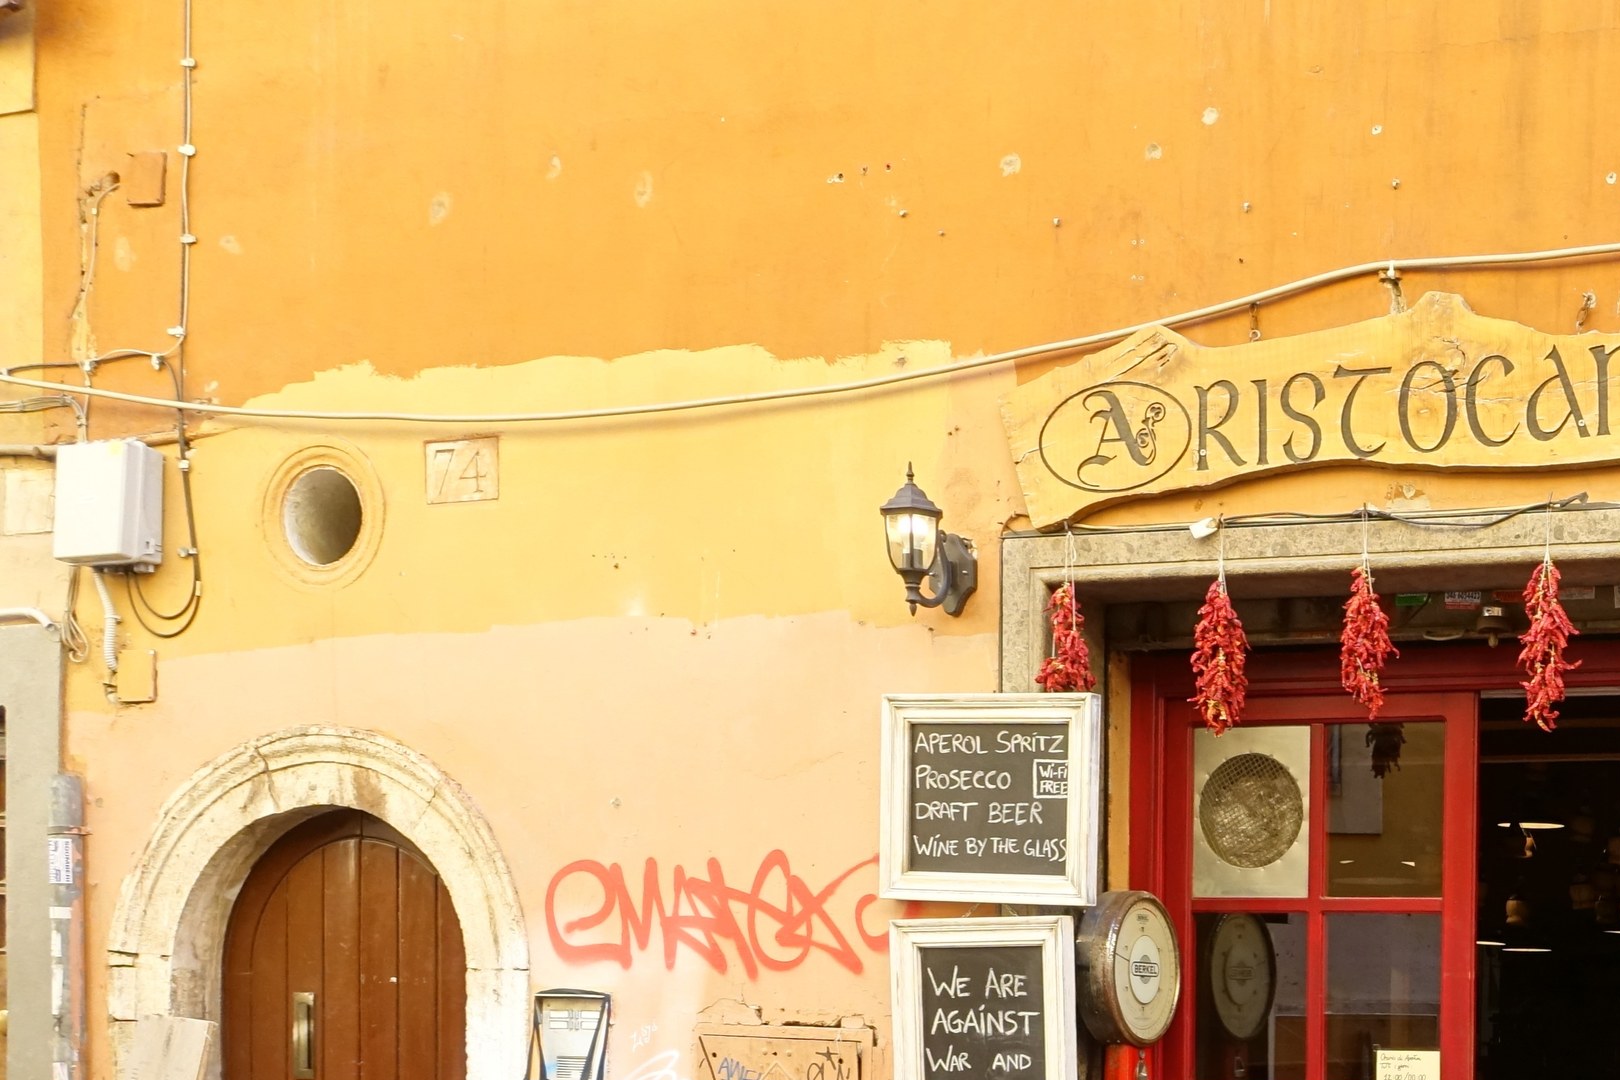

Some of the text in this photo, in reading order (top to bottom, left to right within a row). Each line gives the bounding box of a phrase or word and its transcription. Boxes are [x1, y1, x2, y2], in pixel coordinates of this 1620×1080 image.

[433, 448, 489, 497] 74
[914, 732, 988, 754] APEROL
[915, 764, 1012, 790] PROSECCO
[1040, 780, 1068, 795] FREE
[915, 801, 1043, 826] DRAFT BEER
[965, 837, 987, 857] BY
[990, 837, 1020, 854] THE
[1024, 838, 1067, 862] GLASS
[1134, 963, 1158, 975] BERKEL
[927, 965, 1028, 999] WE ARE
[926, 1045, 1032, 1072] WAR AND
